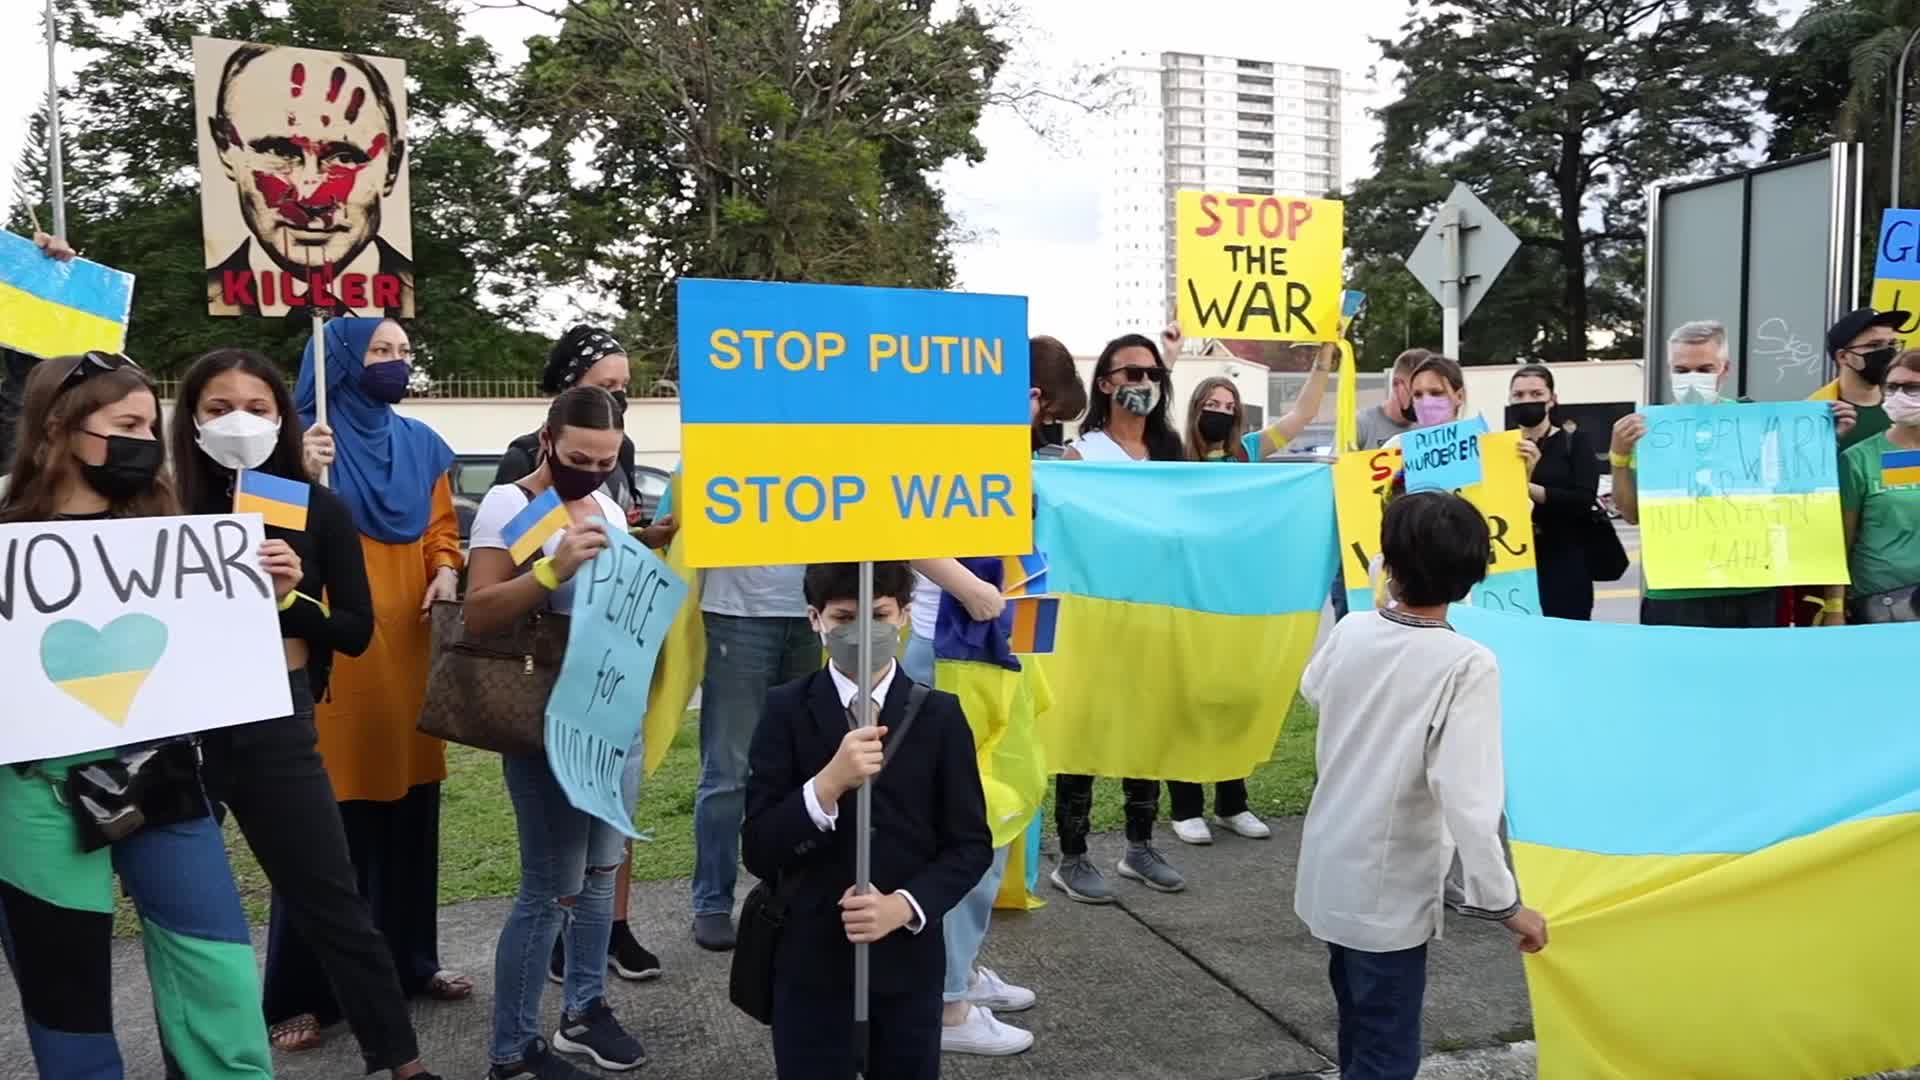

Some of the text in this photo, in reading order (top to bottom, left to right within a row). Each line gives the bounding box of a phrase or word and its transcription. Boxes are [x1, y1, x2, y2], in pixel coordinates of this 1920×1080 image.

[1195, 194, 1313, 241] STOP
[1223, 245, 1288, 276] THE
[222, 269, 402, 308] KILLER
[1187, 278, 1317, 335] WAR
[708, 328, 1004, 375] STOP PUTIN
[1404, 434, 1481, 472] MURDERER
[1414, 424, 1459, 450] PUTIN
[1650, 416, 1734, 450] STOP
[704, 473, 1016, 525] STOP WAR
[93, 519, 271, 604] WAR
[586, 542, 670, 649] PEACE
[585, 647, 626, 714] for
